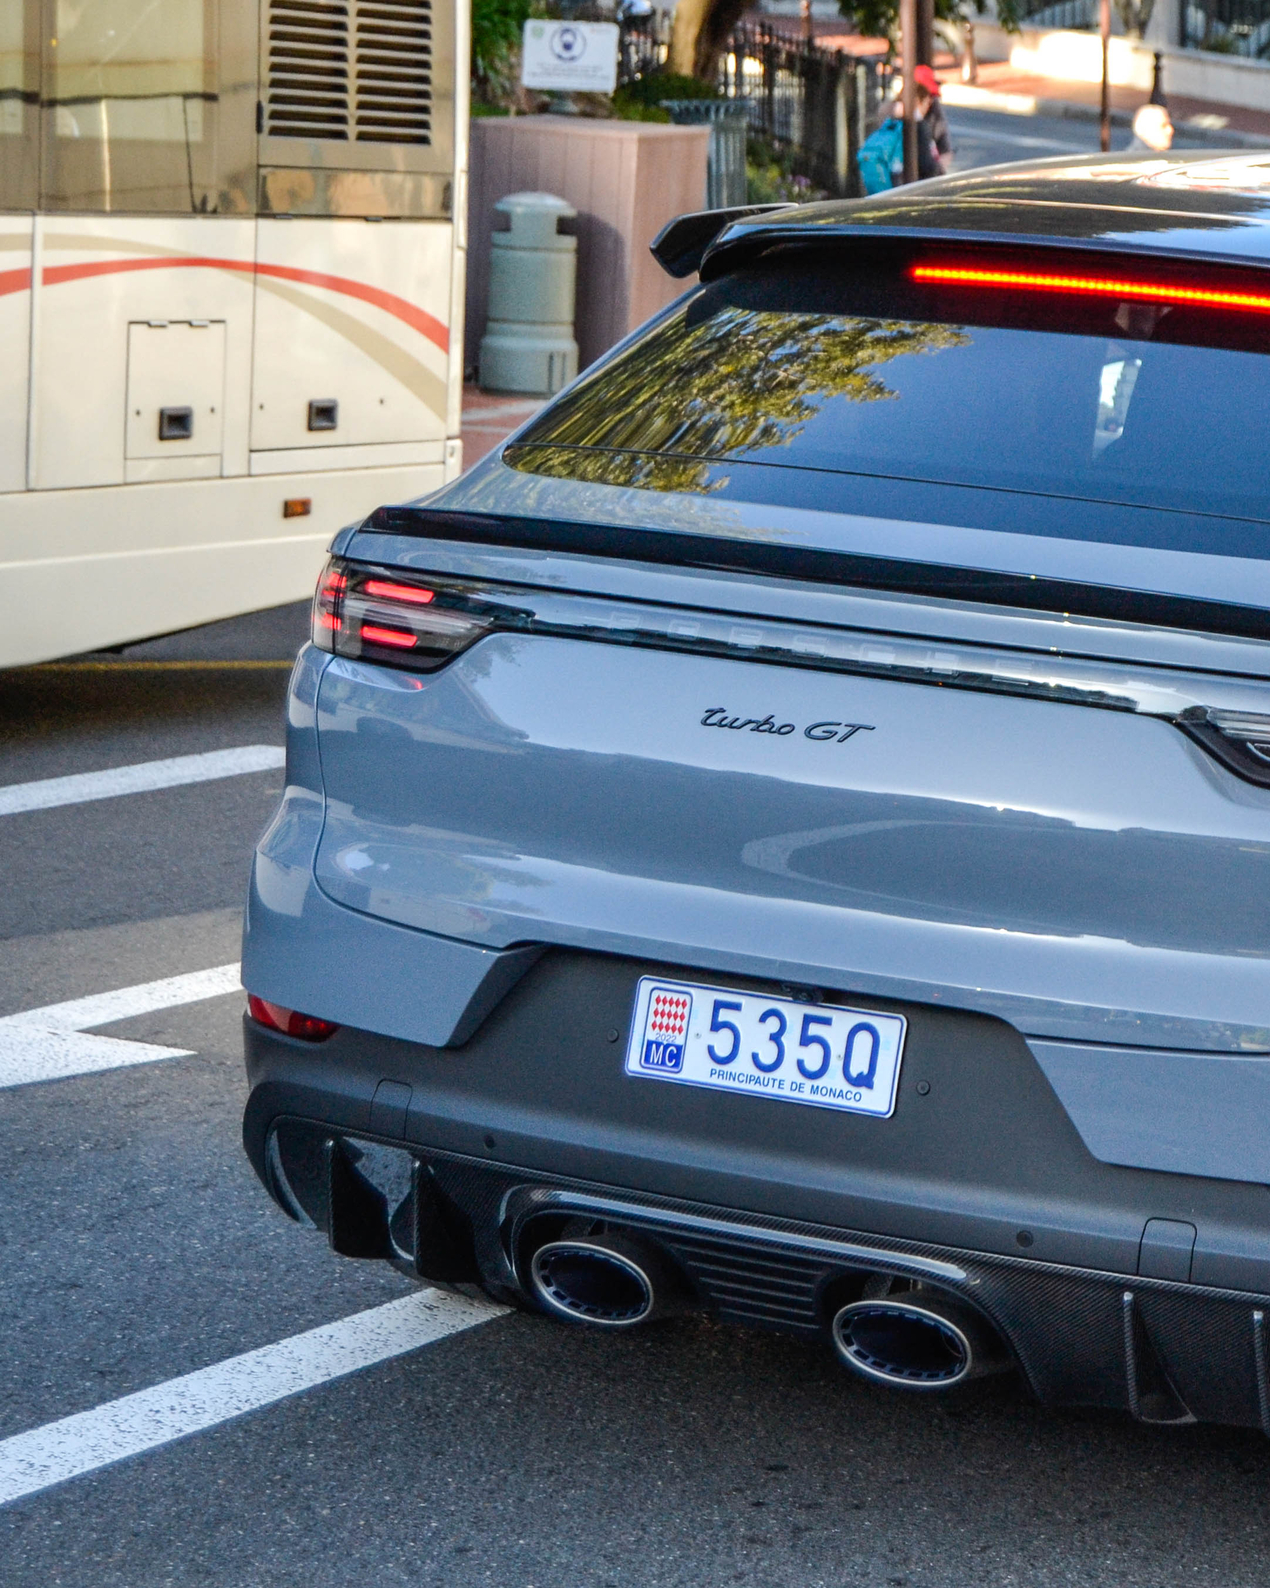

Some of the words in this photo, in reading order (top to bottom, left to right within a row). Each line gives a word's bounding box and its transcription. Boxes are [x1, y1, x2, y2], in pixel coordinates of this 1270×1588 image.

[700, 707, 796, 736] turbo
[803, 721, 877, 743] GT
[655, 1032, 677, 1043] 2022
[706, 998, 881, 1090] 535Q
[649, 1043, 677, 1067] MC
[709, 1068, 786, 1090] PRINCIPAUTE
[789, 1081, 806, 1094] DE
[809, 1084, 863, 1102] MONACO
